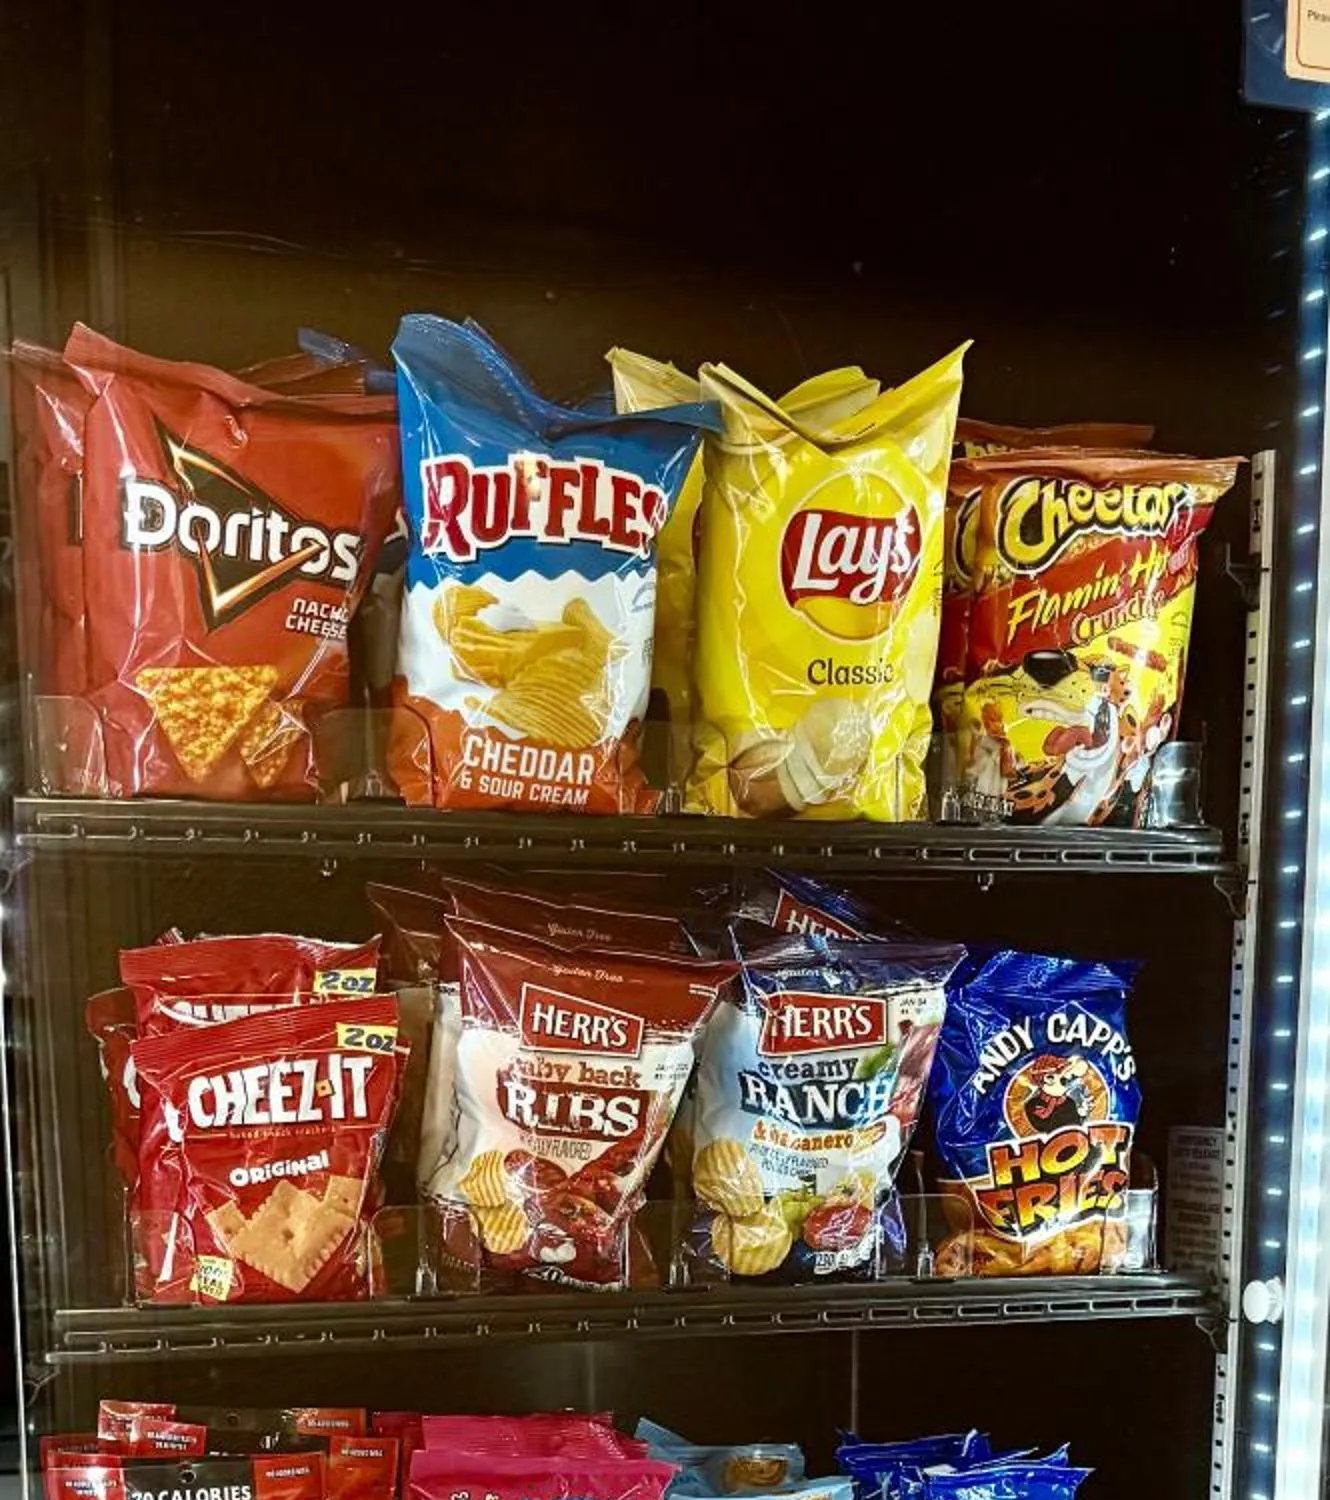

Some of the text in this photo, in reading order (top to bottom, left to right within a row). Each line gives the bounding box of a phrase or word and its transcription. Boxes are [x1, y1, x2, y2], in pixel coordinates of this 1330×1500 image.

[124, 481, 360, 581] Doritos
[423, 457, 668, 559] RUFFLES
[284, 612, 348, 640] CHEESE
[807, 657, 894, 685] Classic
[463, 735, 596, 785] CHEDDAR
[479, 775, 524, 800] SOUR
[529, 783, 590, 805] CREAM
[531, 1002, 628, 1049] HERR'S
[770, 1003, 873, 1039] HERR'S
[578, 1062, 642, 1088] back
[758, 1058, 859, 1082] creamy
[973, 1013, 1137, 1094] ANDY CAPP'S
[503, 1081, 642, 1137] RIBS
[744, 1071, 897, 1125] RANCH
[990, 1126, 1129, 1184] HOT
[978, 1170, 1129, 1229] FRIES
